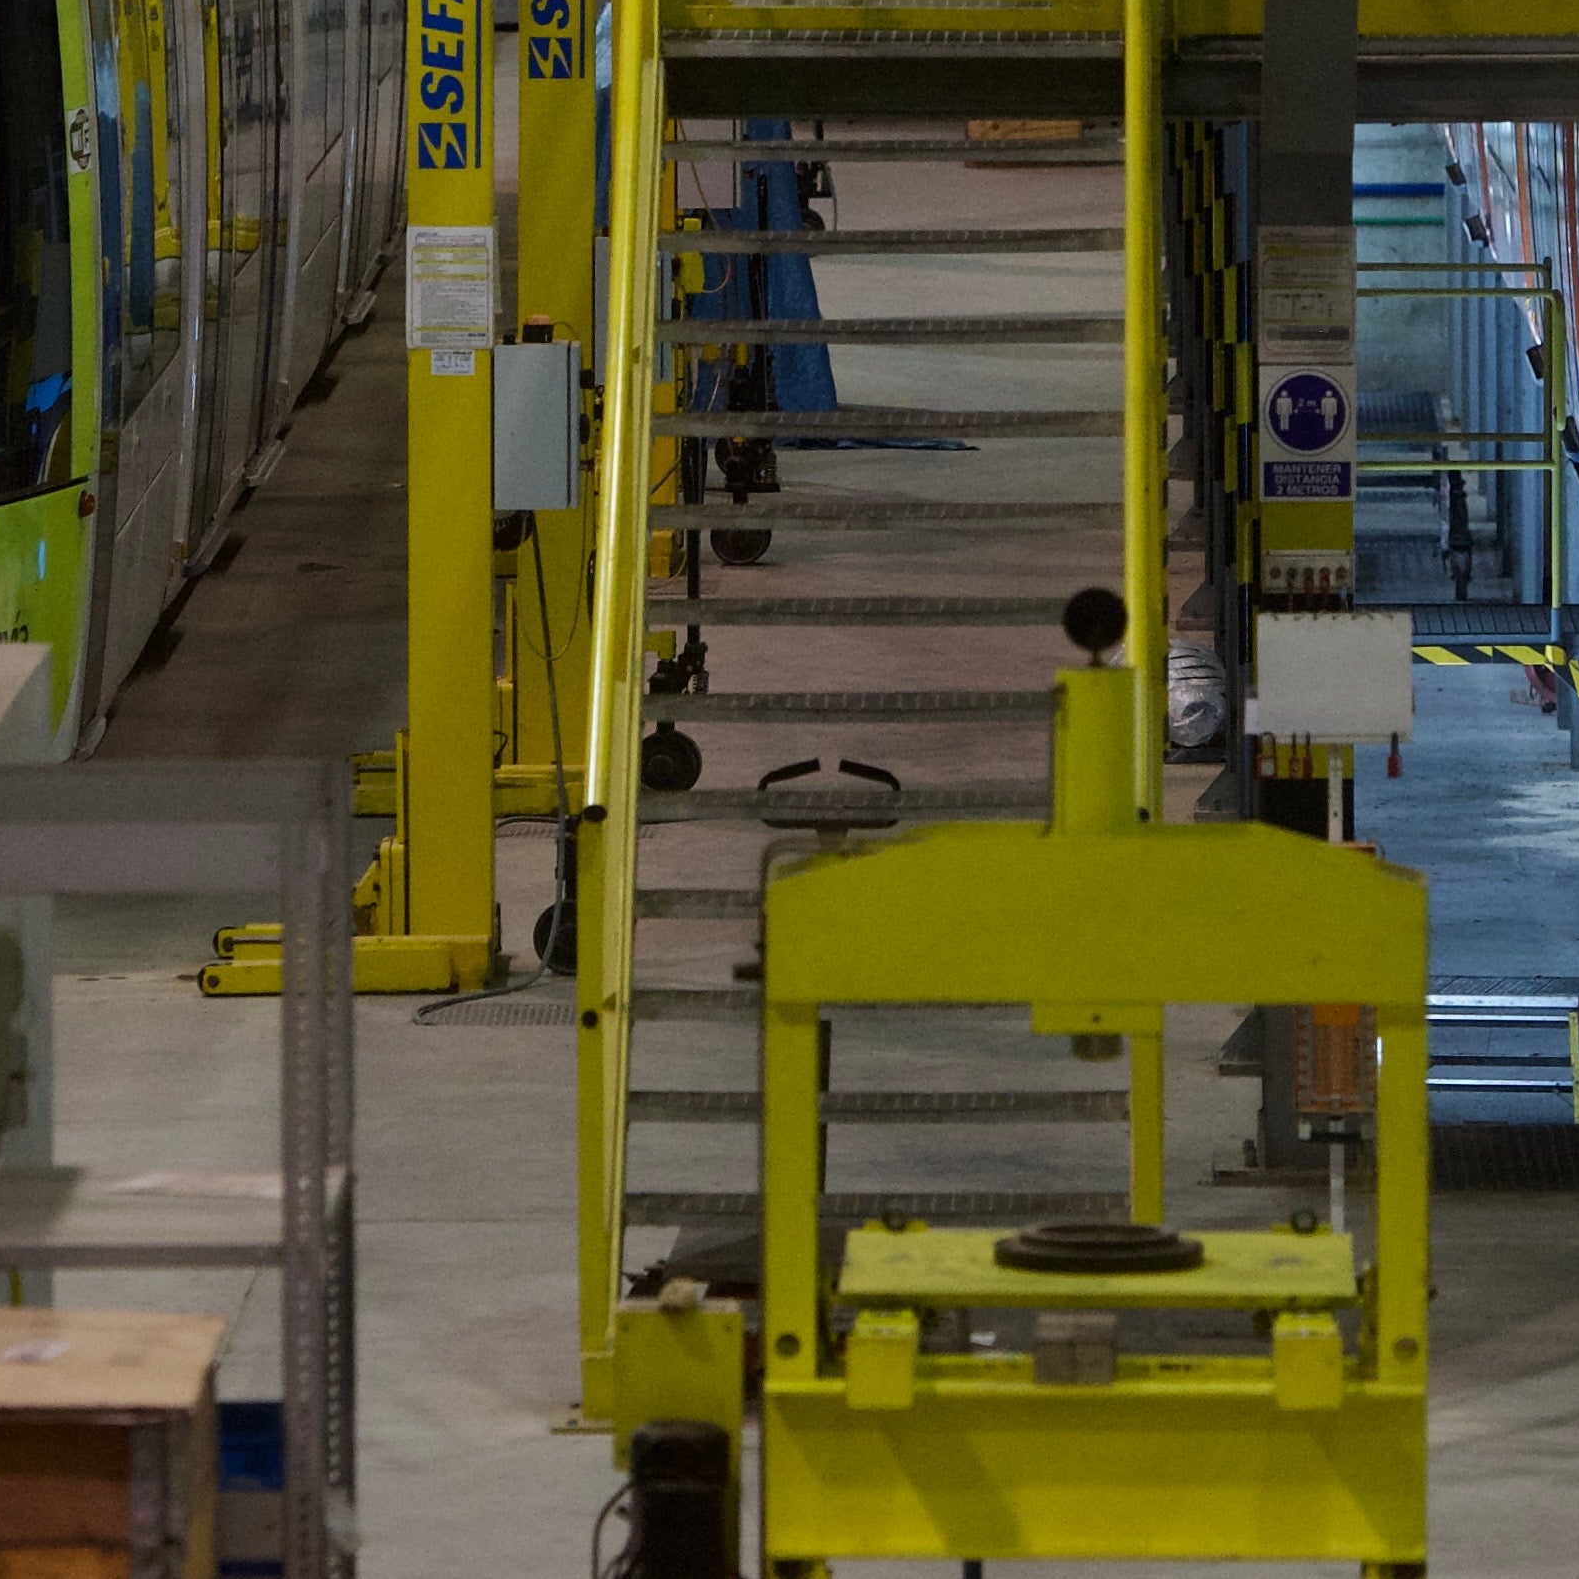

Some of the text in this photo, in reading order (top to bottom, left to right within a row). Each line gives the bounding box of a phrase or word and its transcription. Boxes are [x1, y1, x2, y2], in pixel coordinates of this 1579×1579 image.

[1273, 464, 1341, 473] MANTENER
[1274, 475, 1340, 484] DISTANCIA
[1276, 486, 1339, 494] 2 METROS
